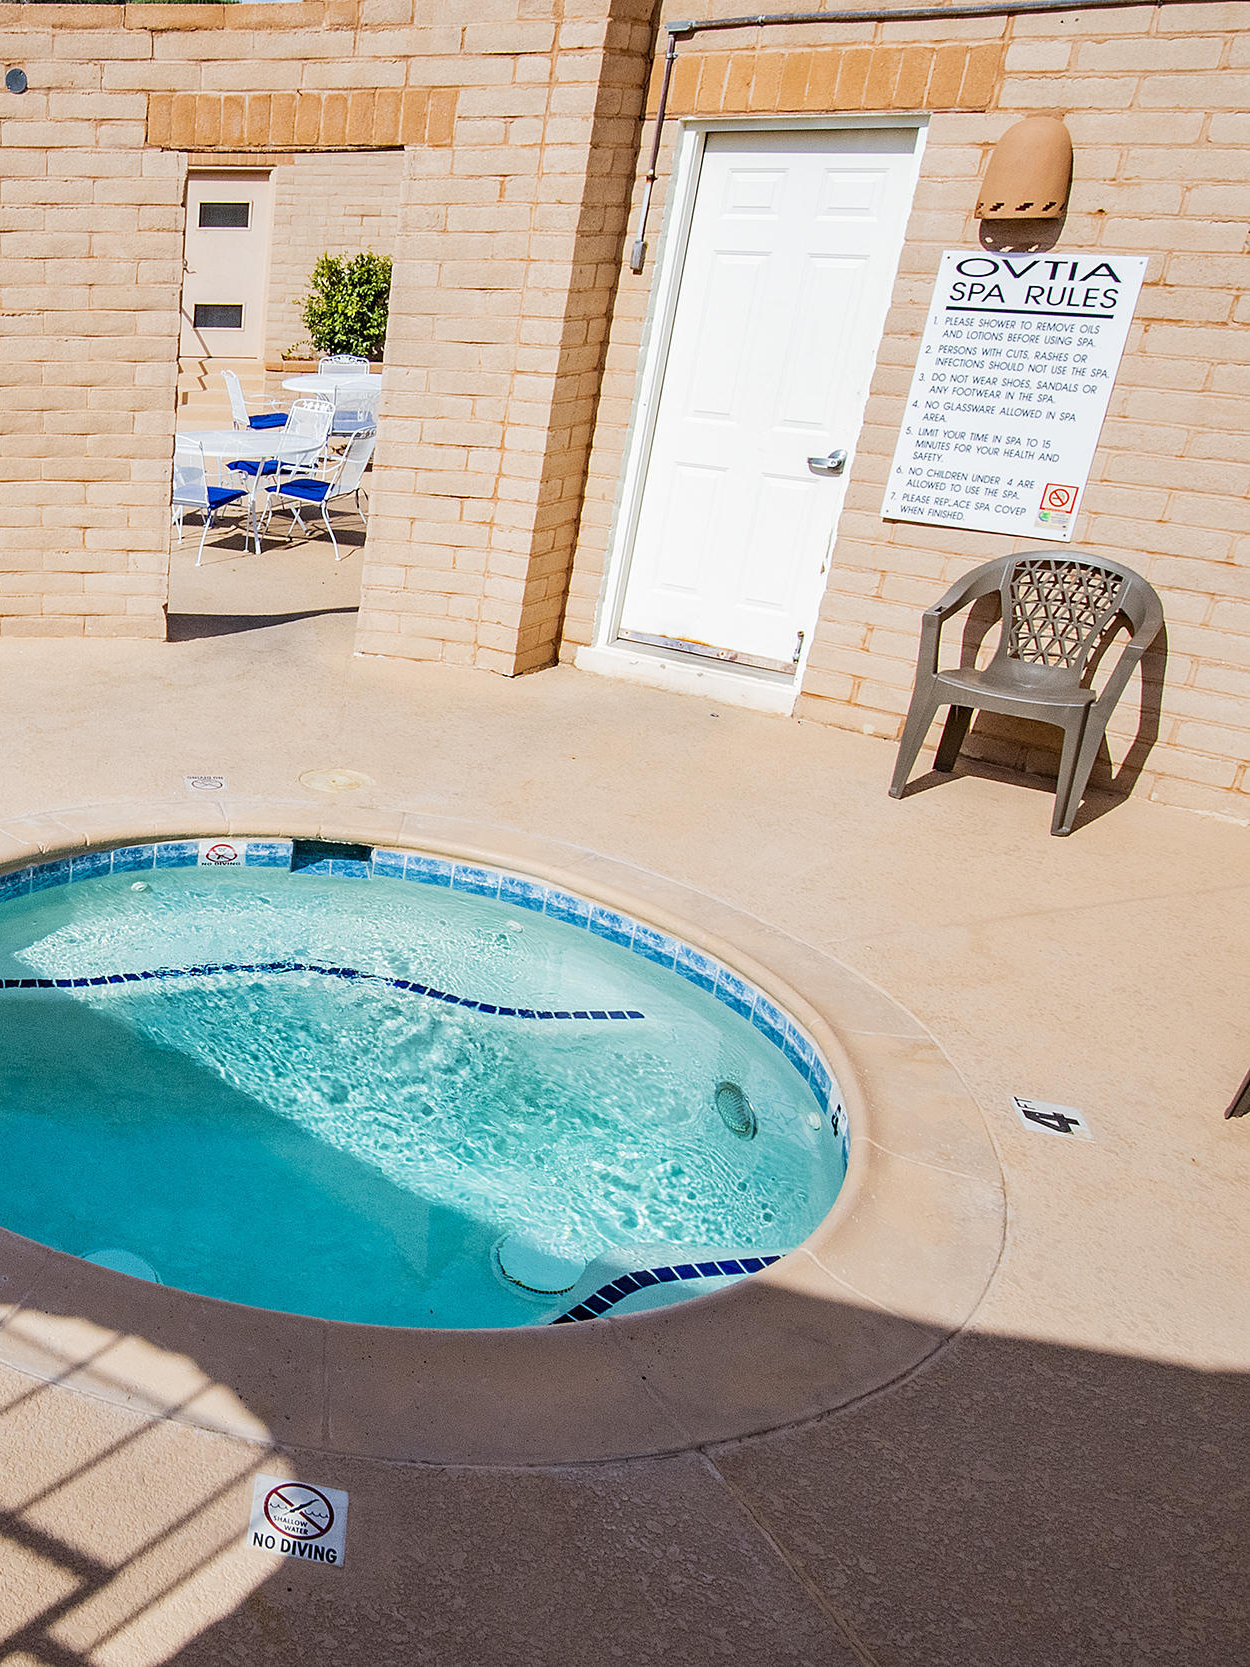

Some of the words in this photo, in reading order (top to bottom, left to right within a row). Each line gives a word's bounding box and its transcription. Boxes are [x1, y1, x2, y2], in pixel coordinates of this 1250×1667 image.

[956, 258, 1122, 283] OVTIA
[950, 282, 1005, 303] SPA
[1024, 286, 1119, 309] RULES
[944, 317, 975, 327] PLEASE
[978, 319, 1016, 329] SHOWER
[1020, 321, 1033, 330] TO
[1036, 322, 1075, 333] REMOVE
[1079, 324, 1101, 334] OILS
[942, 330, 963, 339] AND
[966, 331, 1004, 341] LOTIONS
[1007, 333, 1040, 343] BEFORE
[1044, 336, 1073, 346] USING
[938, 345, 978, 356] PERSONS
[981, 348, 1003, 357] WITH
[1034, 351, 1069, 362] RASHES
[1072, 354, 1088, 363] OR
[935, 358, 985, 369] INFECTIONS
[988, 361, 1025, 372] SHOULD
[1027, 364, 1048, 374] NOT
[1050, 365, 1068, 375] USE
[1071, 367, 1087, 377] THE
[1090, 368, 1110, 379] SPA.
[929, 386, 949, 395] ANY
[951, 387, 1002, 399] FOOTWEAR
[1005, 391, 1015, 400] IN
[1018, 392, 1034, 402] THE
[931, 373, 947, 382] DO
[950, 374, 969, 384] NOT
[972, 376, 999, 386] WEAR
[1036, 381, 1079, 393] SANDALS
[1082, 384, 1098, 394] OR
[925, 401, 940, 410] NO
[943, 402, 996, 414] GLASSWARE
[999, 407, 1043, 419] ALLOWED
[1046, 411, 1056, 420] IN
[1059, 412, 1077, 422] SPA
[918, 427, 939, 437] LIMIT
[943, 430, 967, 440] YOUR
[970, 432, 989, 442] TIME
[992, 434, 1002, 443] IN
[1005, 436, 1022, 446] SPA
[1026, 438, 1039, 447] TO
[1042, 440, 1052, 449] 15
[915, 440, 951, 451] MINUTES
[954, 443, 972, 453] FOR
[976, 446, 1000, 456] YOUR
[1003, 448, 1036, 460] HEALTH
[1038, 453, 1060, 463] AND
[905, 479, 947, 491] ALLOWED
[950, 484, 962, 493] TO
[965, 485, 981, 495] USE
[984, 487, 999, 498] THE
[908, 467, 924, 476] NO
[926, 469, 969, 481] CHILDREN
[971, 474, 1001, 485] UNDER
[1017, 479, 1035, 489] ARE
[900, 505, 925, 515] WHEN
[927, 508, 965, 521] FINISHED.
[902, 493, 931, 505] PLEASE
[974, 502, 991, 512] SPA
[831, 1104, 842, 1138] 4
[1022, 1109, 1081, 1135] 4
[273, 1515, 309, 1528] SHALLOW
[284, 1524, 309, 1536] WATER
[253, 1532, 276, 1550] NO
[280, 1538, 338, 1564] DIVING
